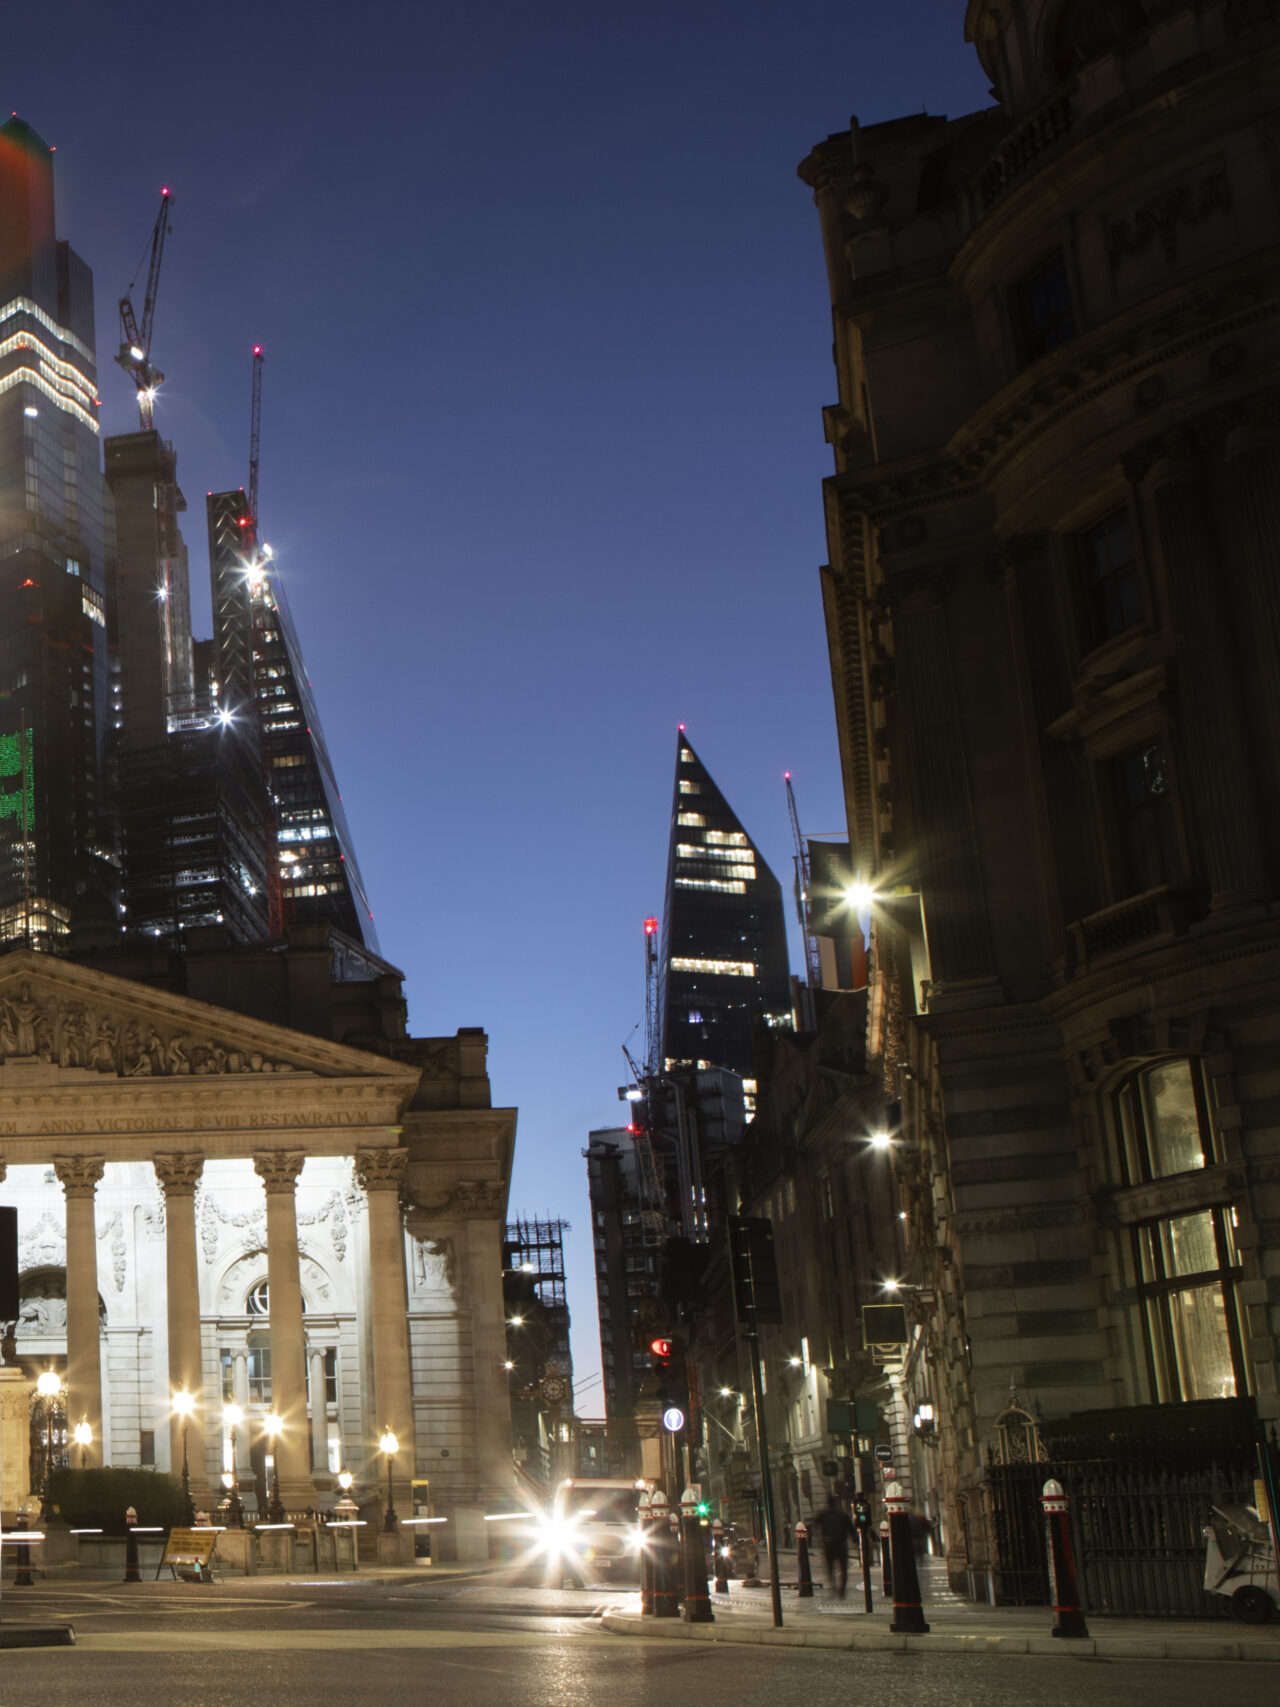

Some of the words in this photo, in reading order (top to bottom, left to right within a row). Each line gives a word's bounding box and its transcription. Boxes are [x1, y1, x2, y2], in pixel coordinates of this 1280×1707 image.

[39, 1119, 86, 1133] ANNO
[96, 1116, 184, 1132] VICTORIAE
[192, 1116, 205, 1128] R
[215, 1114, 241, 1128] VIII
[249, 1110, 369, 1127] RESTAVRATVM
